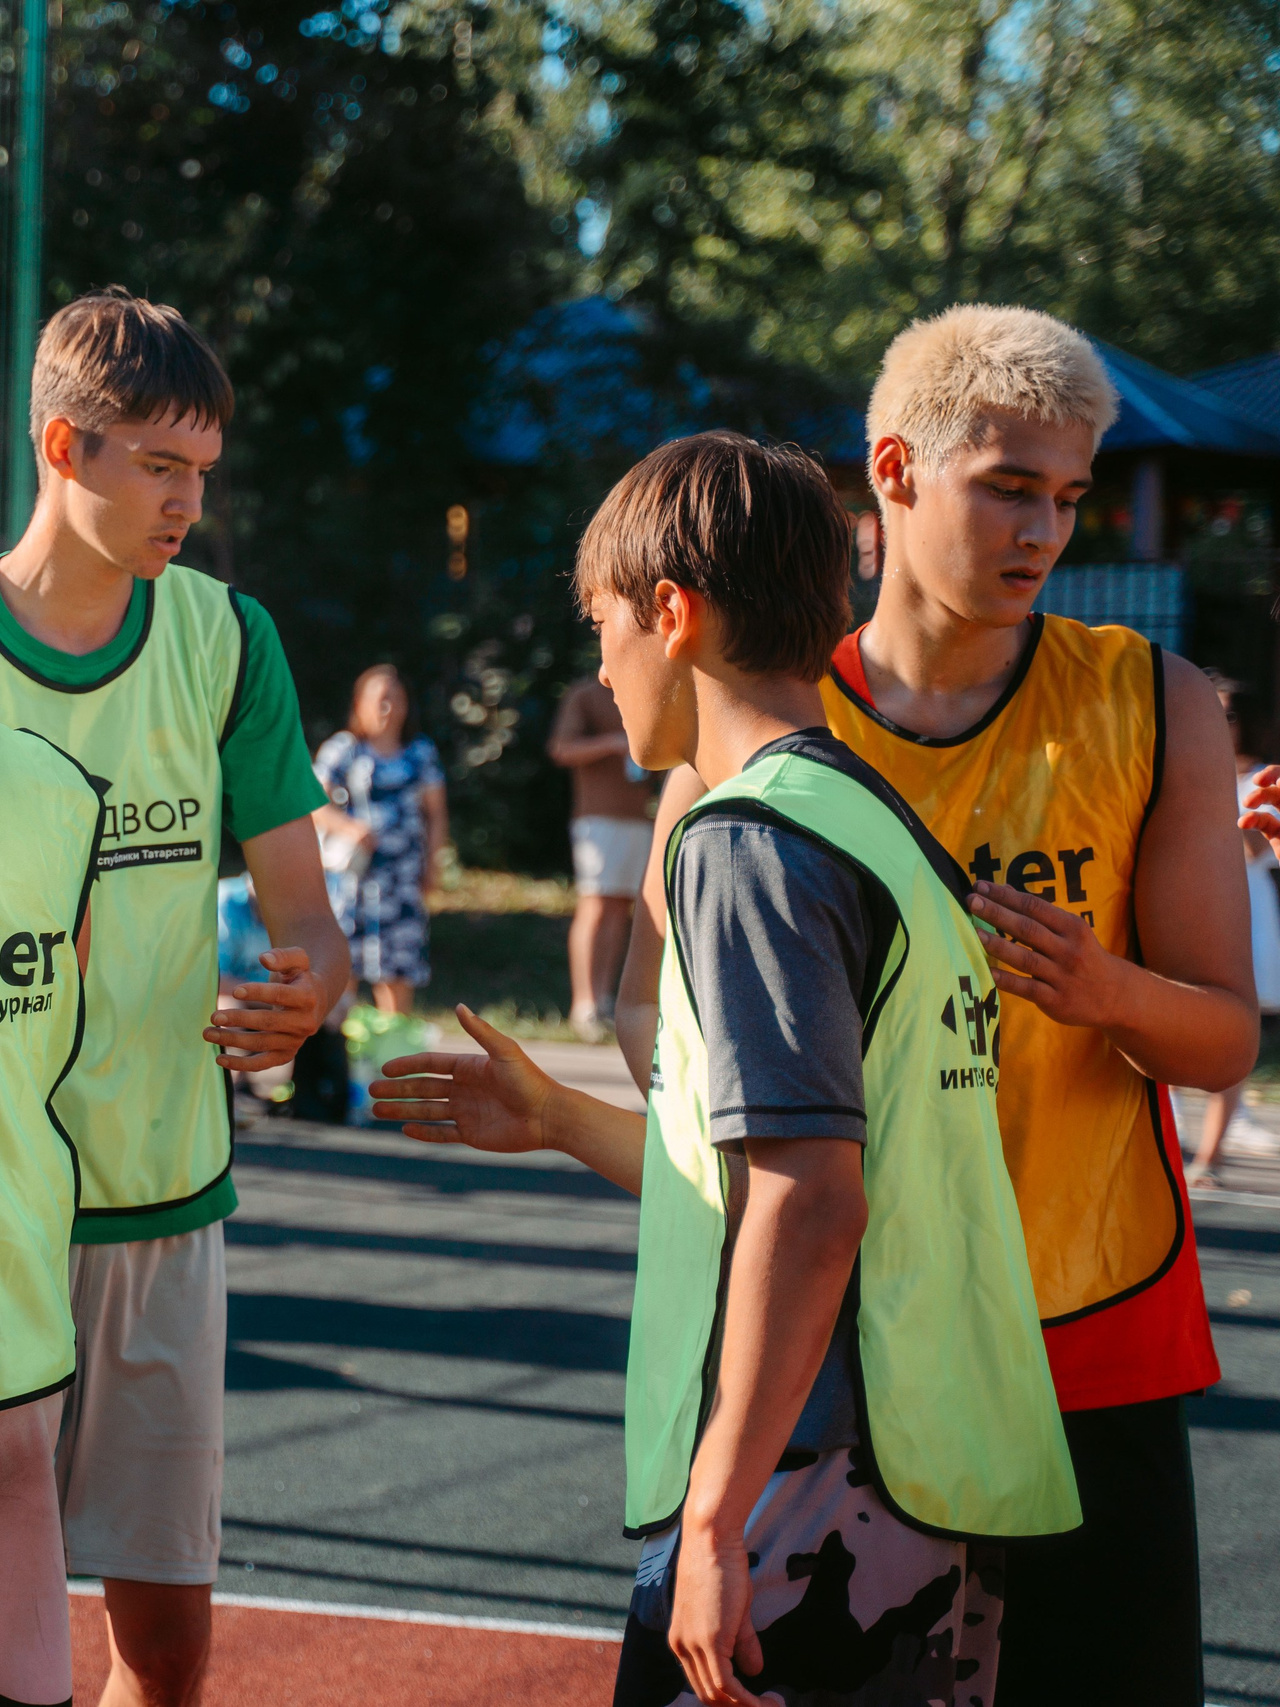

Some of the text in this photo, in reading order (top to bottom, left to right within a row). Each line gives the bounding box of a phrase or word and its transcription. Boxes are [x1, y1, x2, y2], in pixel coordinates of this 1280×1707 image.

[97, 846, 197, 867] спублики Татарстан
[969, 842, 1095, 903] ter
